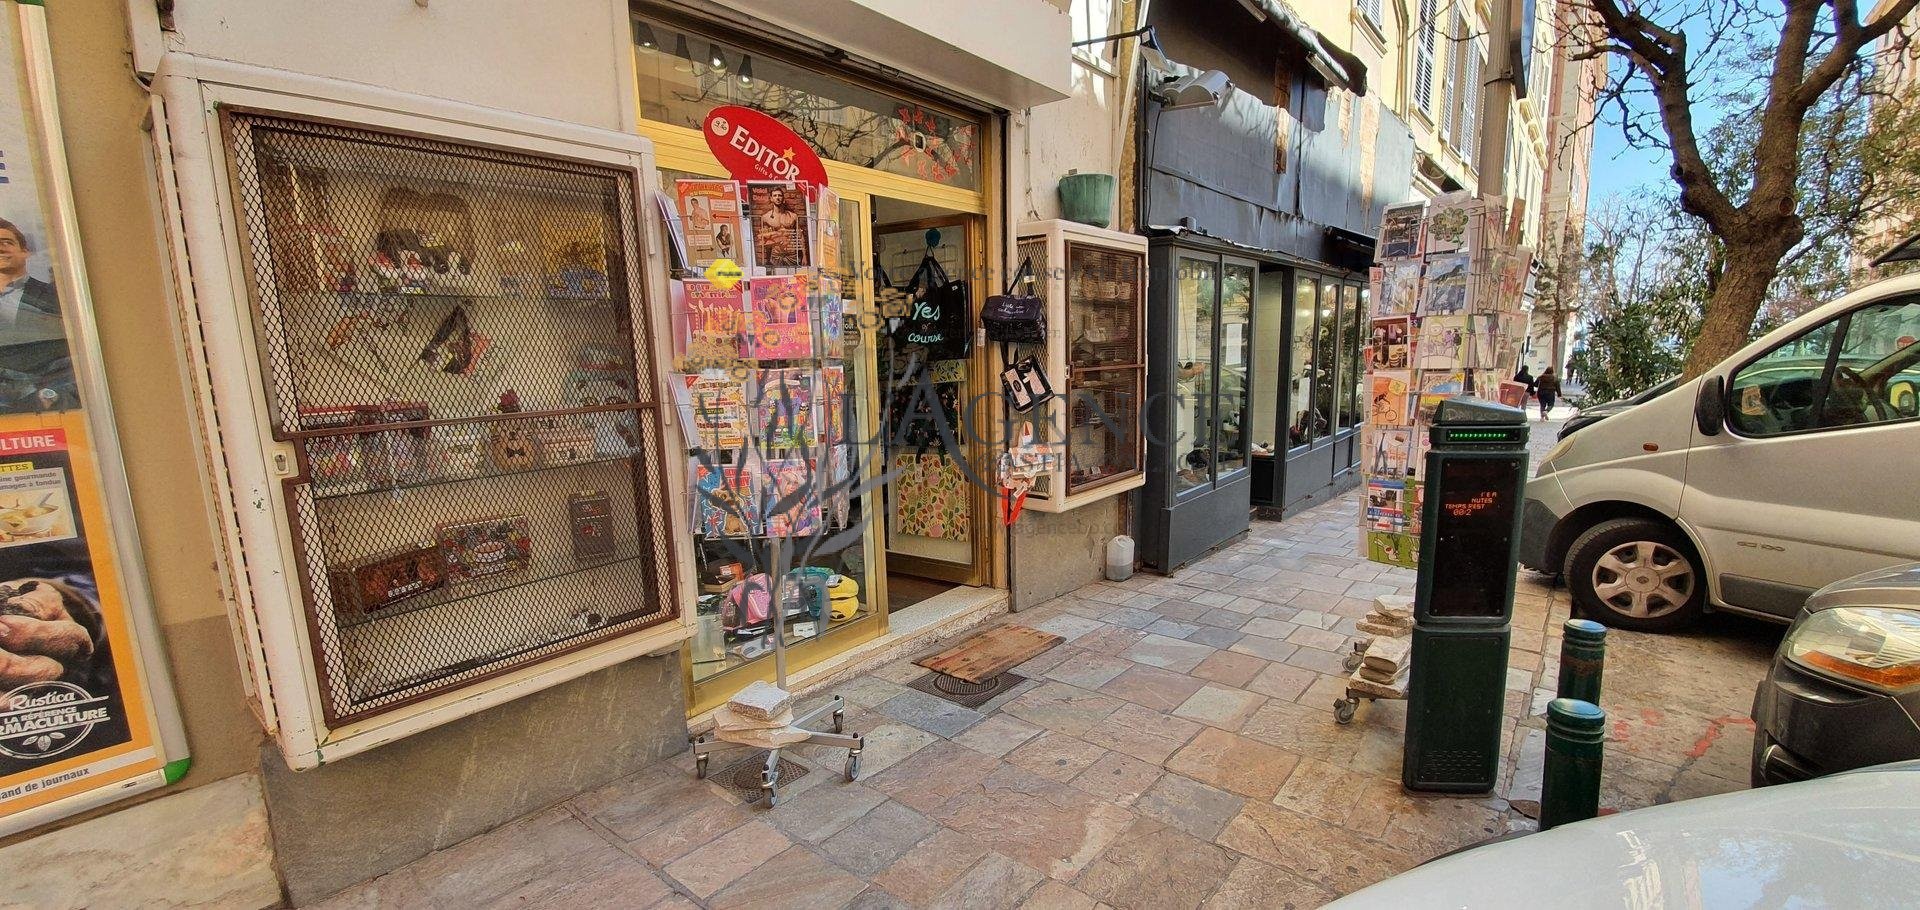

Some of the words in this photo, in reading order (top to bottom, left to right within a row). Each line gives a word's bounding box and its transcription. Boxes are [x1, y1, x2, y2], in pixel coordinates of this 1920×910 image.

[729, 124, 800, 181] EDITOR
[912, 301, 942, 322] Yes
[907, 332, 945, 344] course
[0, 434, 56, 451] LTURE
[9, 691, 76, 711] Rustica
[4, 717, 19, 725] LA
[0, 787, 22, 801] and
[25, 781, 39, 793] de
[40, 767, 91, 789] journaux
